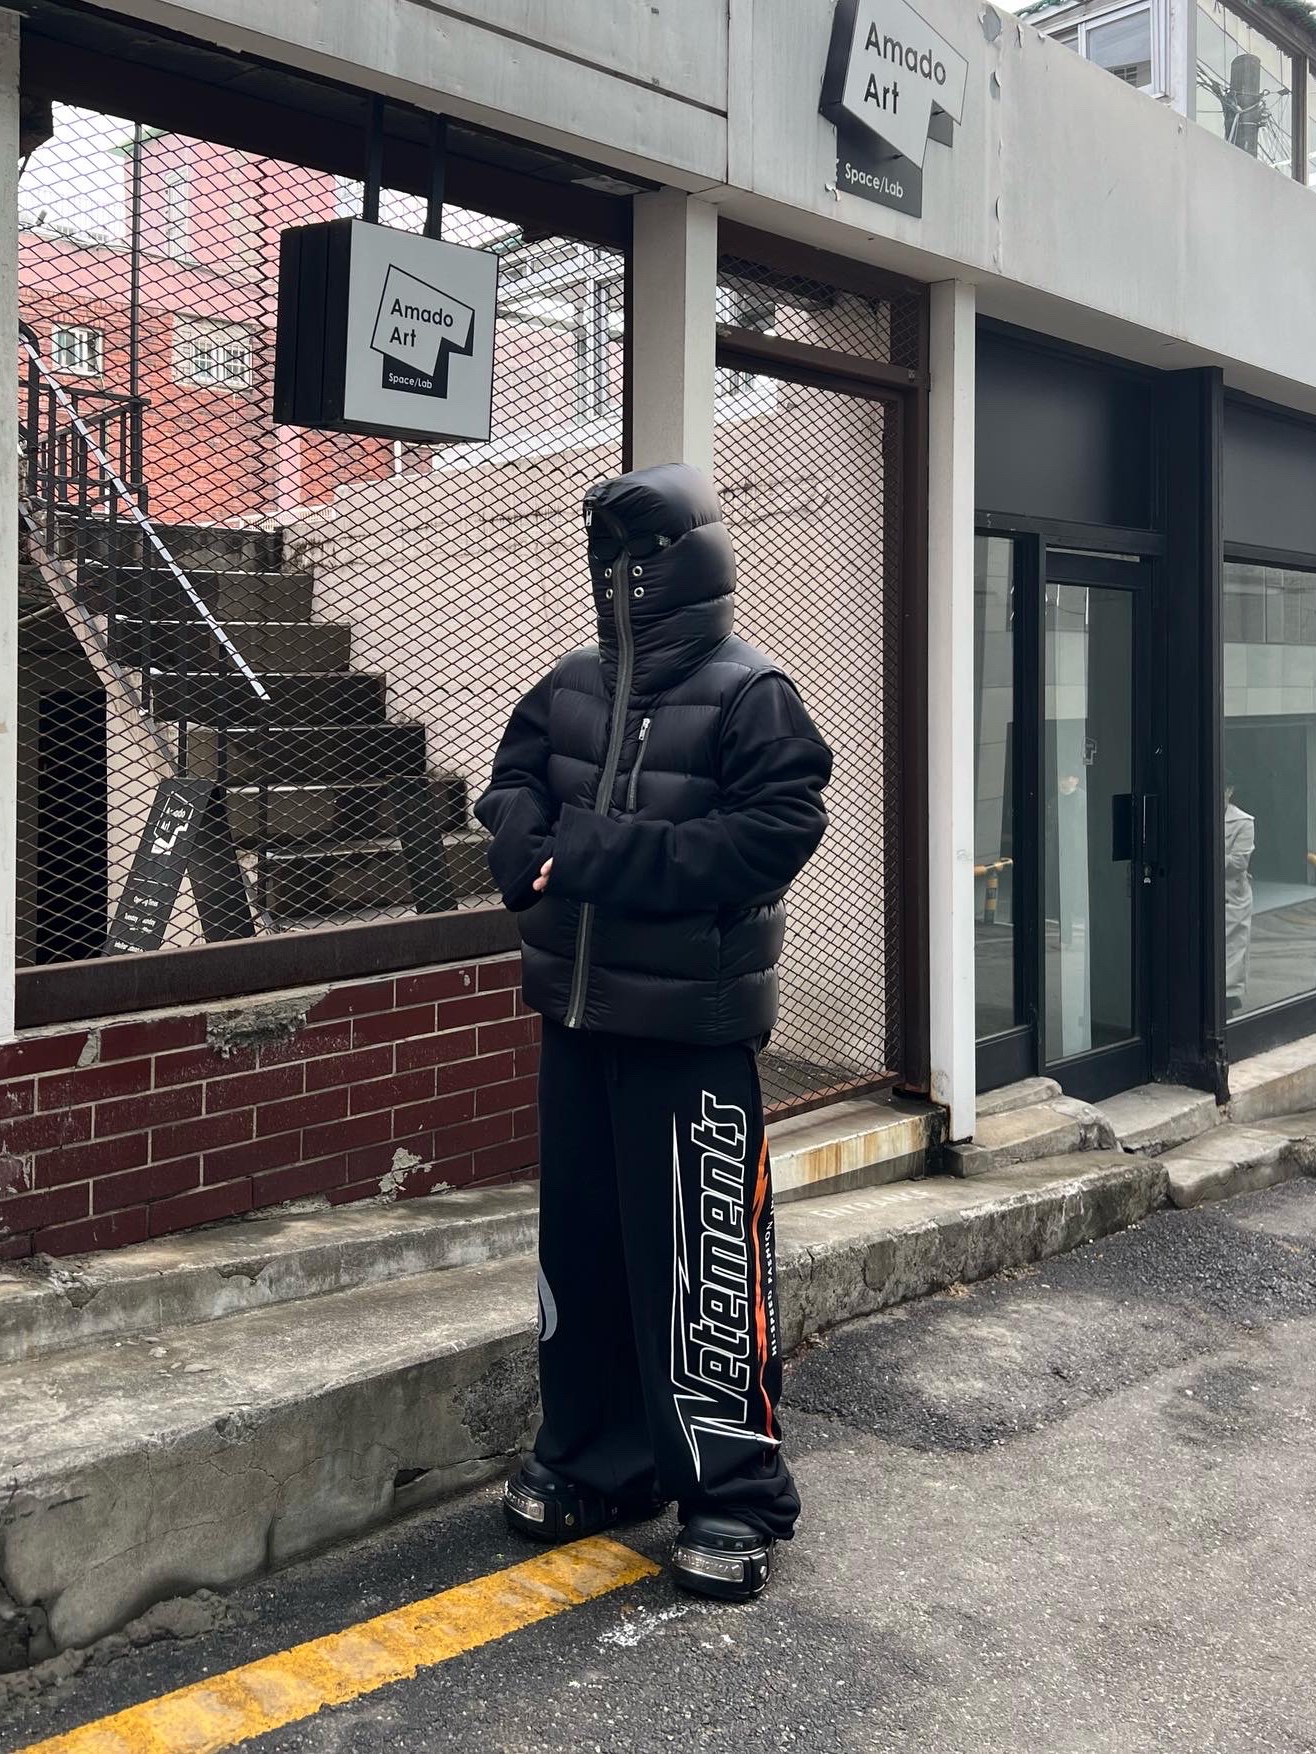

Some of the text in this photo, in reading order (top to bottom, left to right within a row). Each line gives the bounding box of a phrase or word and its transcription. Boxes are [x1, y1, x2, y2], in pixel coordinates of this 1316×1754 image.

[865, 21, 946, 85] Amado
[864, 72, 899, 114] Art
[845, 162, 904, 199] Space/Lab
[390, 298, 453, 328] Amado
[389, 326, 417, 348] Art
[388, 372, 433, 389] Space/Lab
[764, 1220, 774, 1284] FASHION
[671, 1090, 781, 1481] Vetements
[767, 1289, 778, 1357] HI-SPEED
